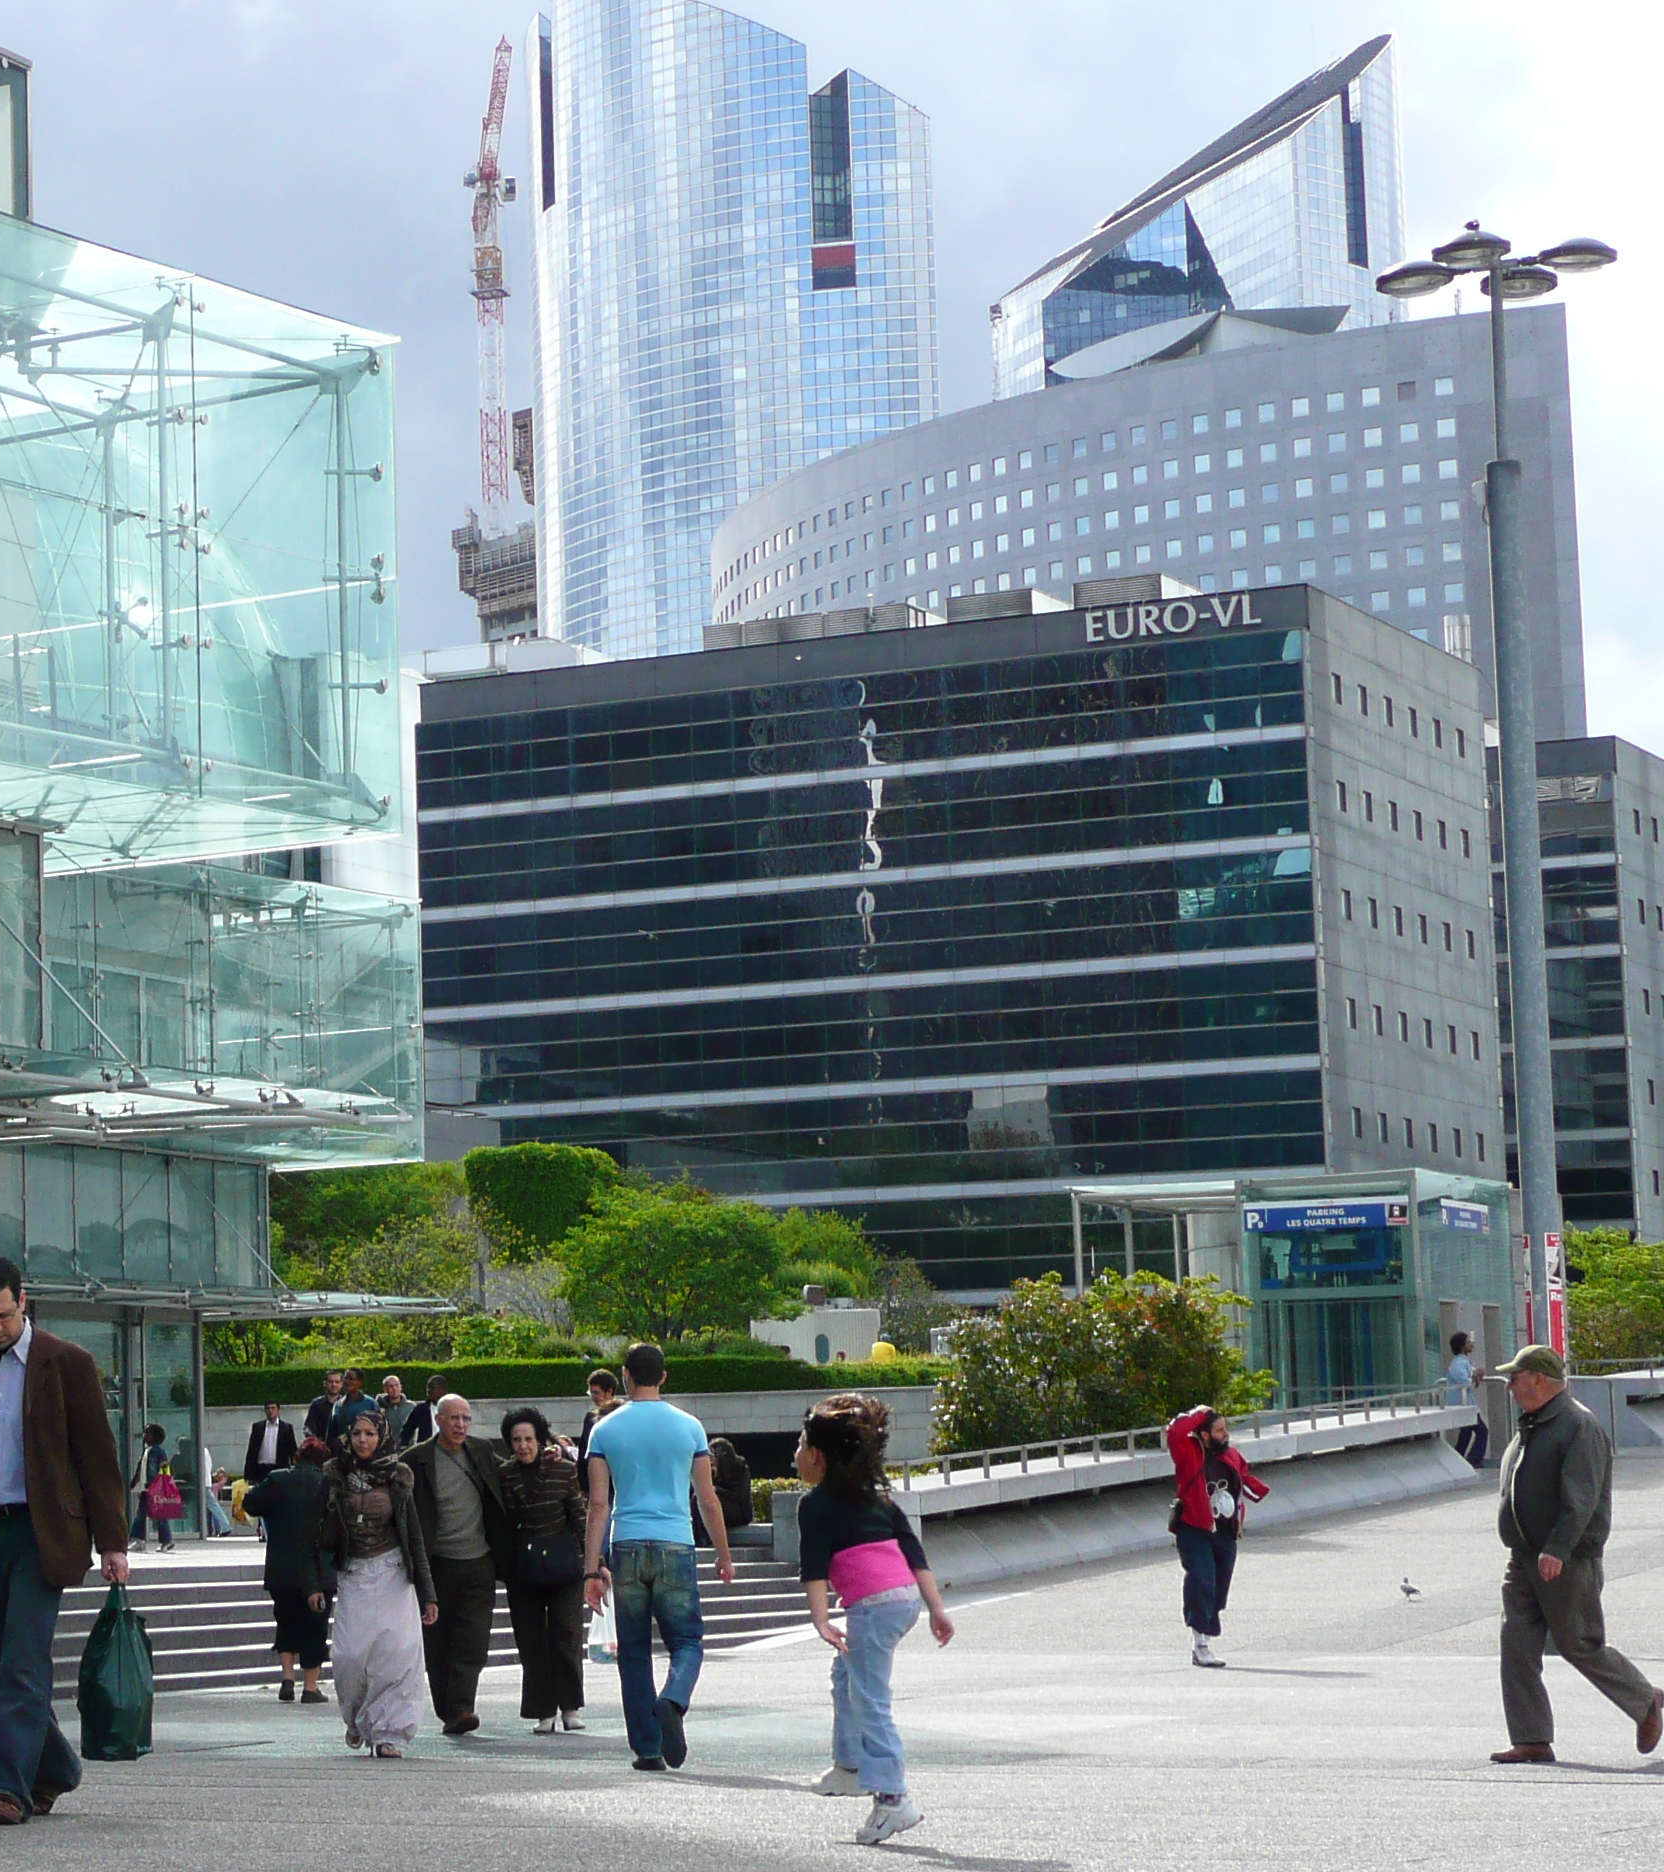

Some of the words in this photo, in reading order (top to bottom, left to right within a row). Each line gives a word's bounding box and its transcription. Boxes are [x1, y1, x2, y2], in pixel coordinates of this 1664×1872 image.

[1085, 594, 1263, 643] EURO-VL
[1306, 1207, 1346, 1217] PARKING
[1286, 1218, 1302, 1228] LES
[1303, 1217, 1336, 1227] QUATRE
[1338, 1216, 1367, 1226] TEMPS
